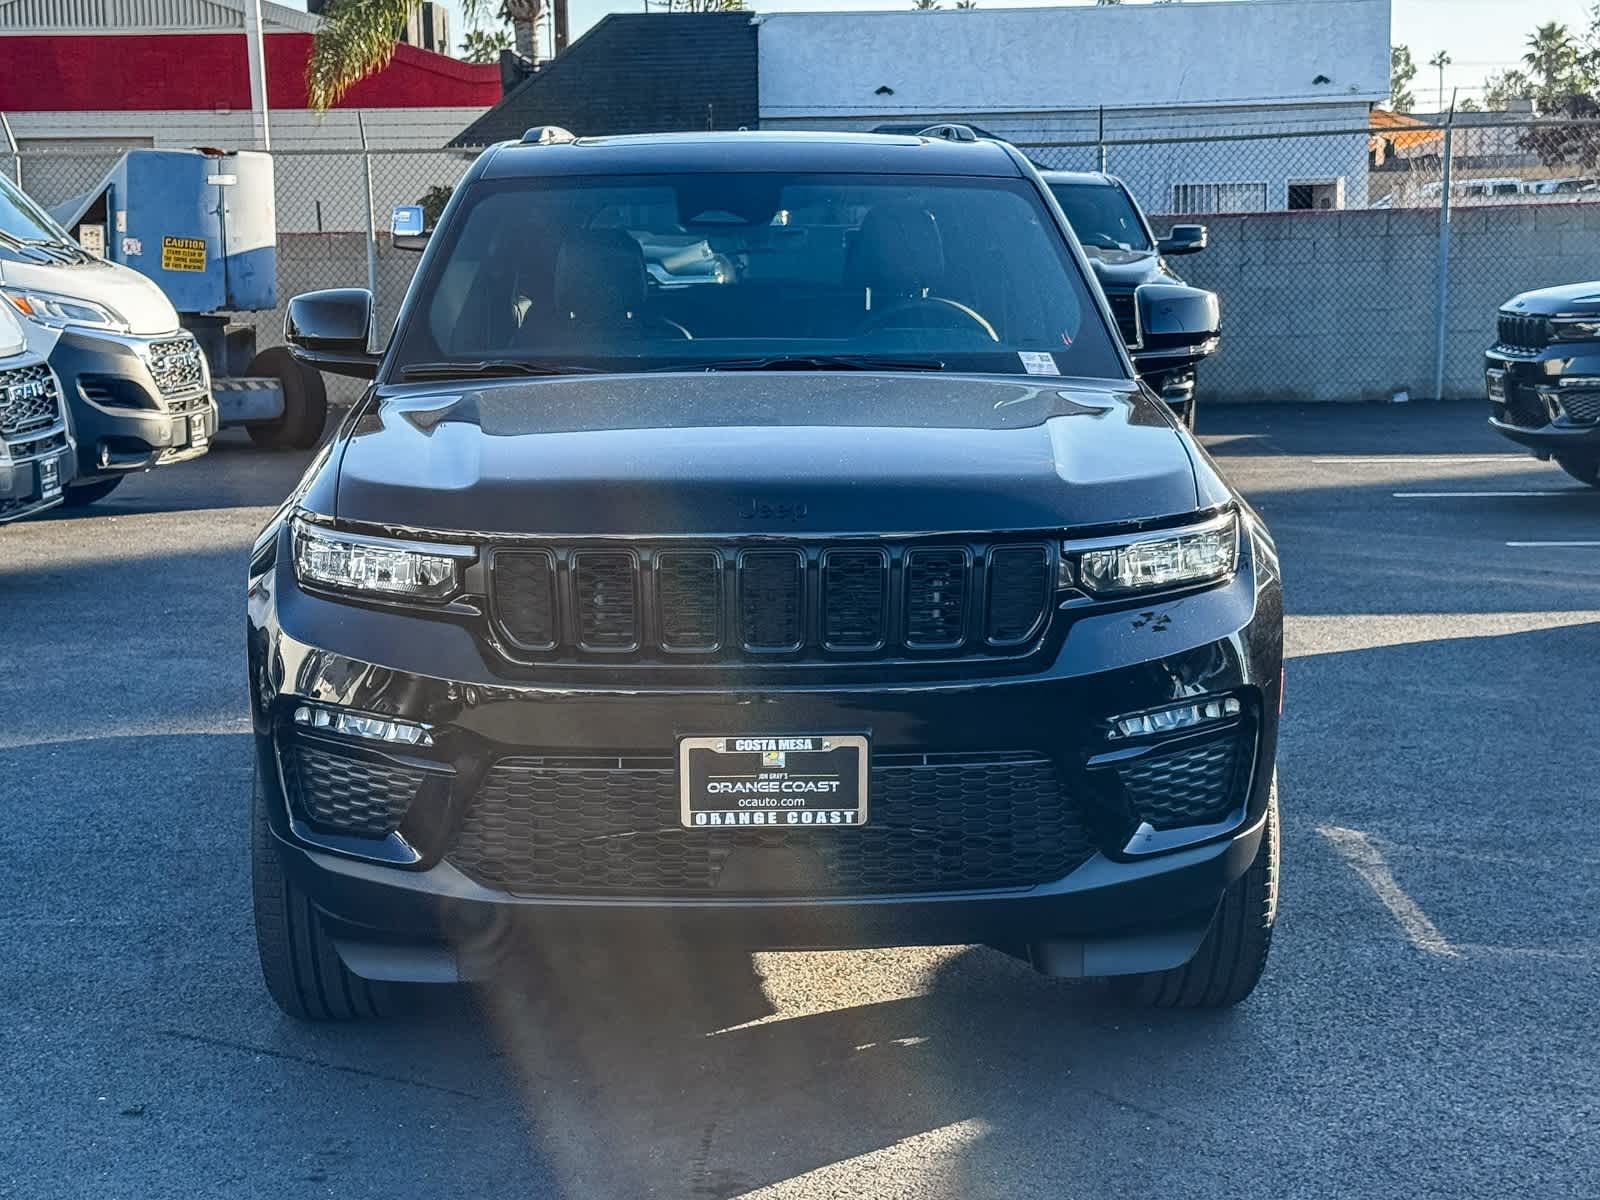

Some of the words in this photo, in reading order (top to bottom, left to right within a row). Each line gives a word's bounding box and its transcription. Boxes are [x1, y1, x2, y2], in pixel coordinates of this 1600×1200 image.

[165, 238, 204, 249] CAUTION
[738, 496, 808, 523] Jeep
[735, 739, 777, 751] COSTA
[779, 738, 813, 750] MESA
[707, 781, 779, 793] ORANGE
[781, 781, 840, 793] COAST
[738, 797, 805, 807] ocauto.com
[695, 811, 777, 825] ORANGE
[787, 811, 854, 824] COAST
